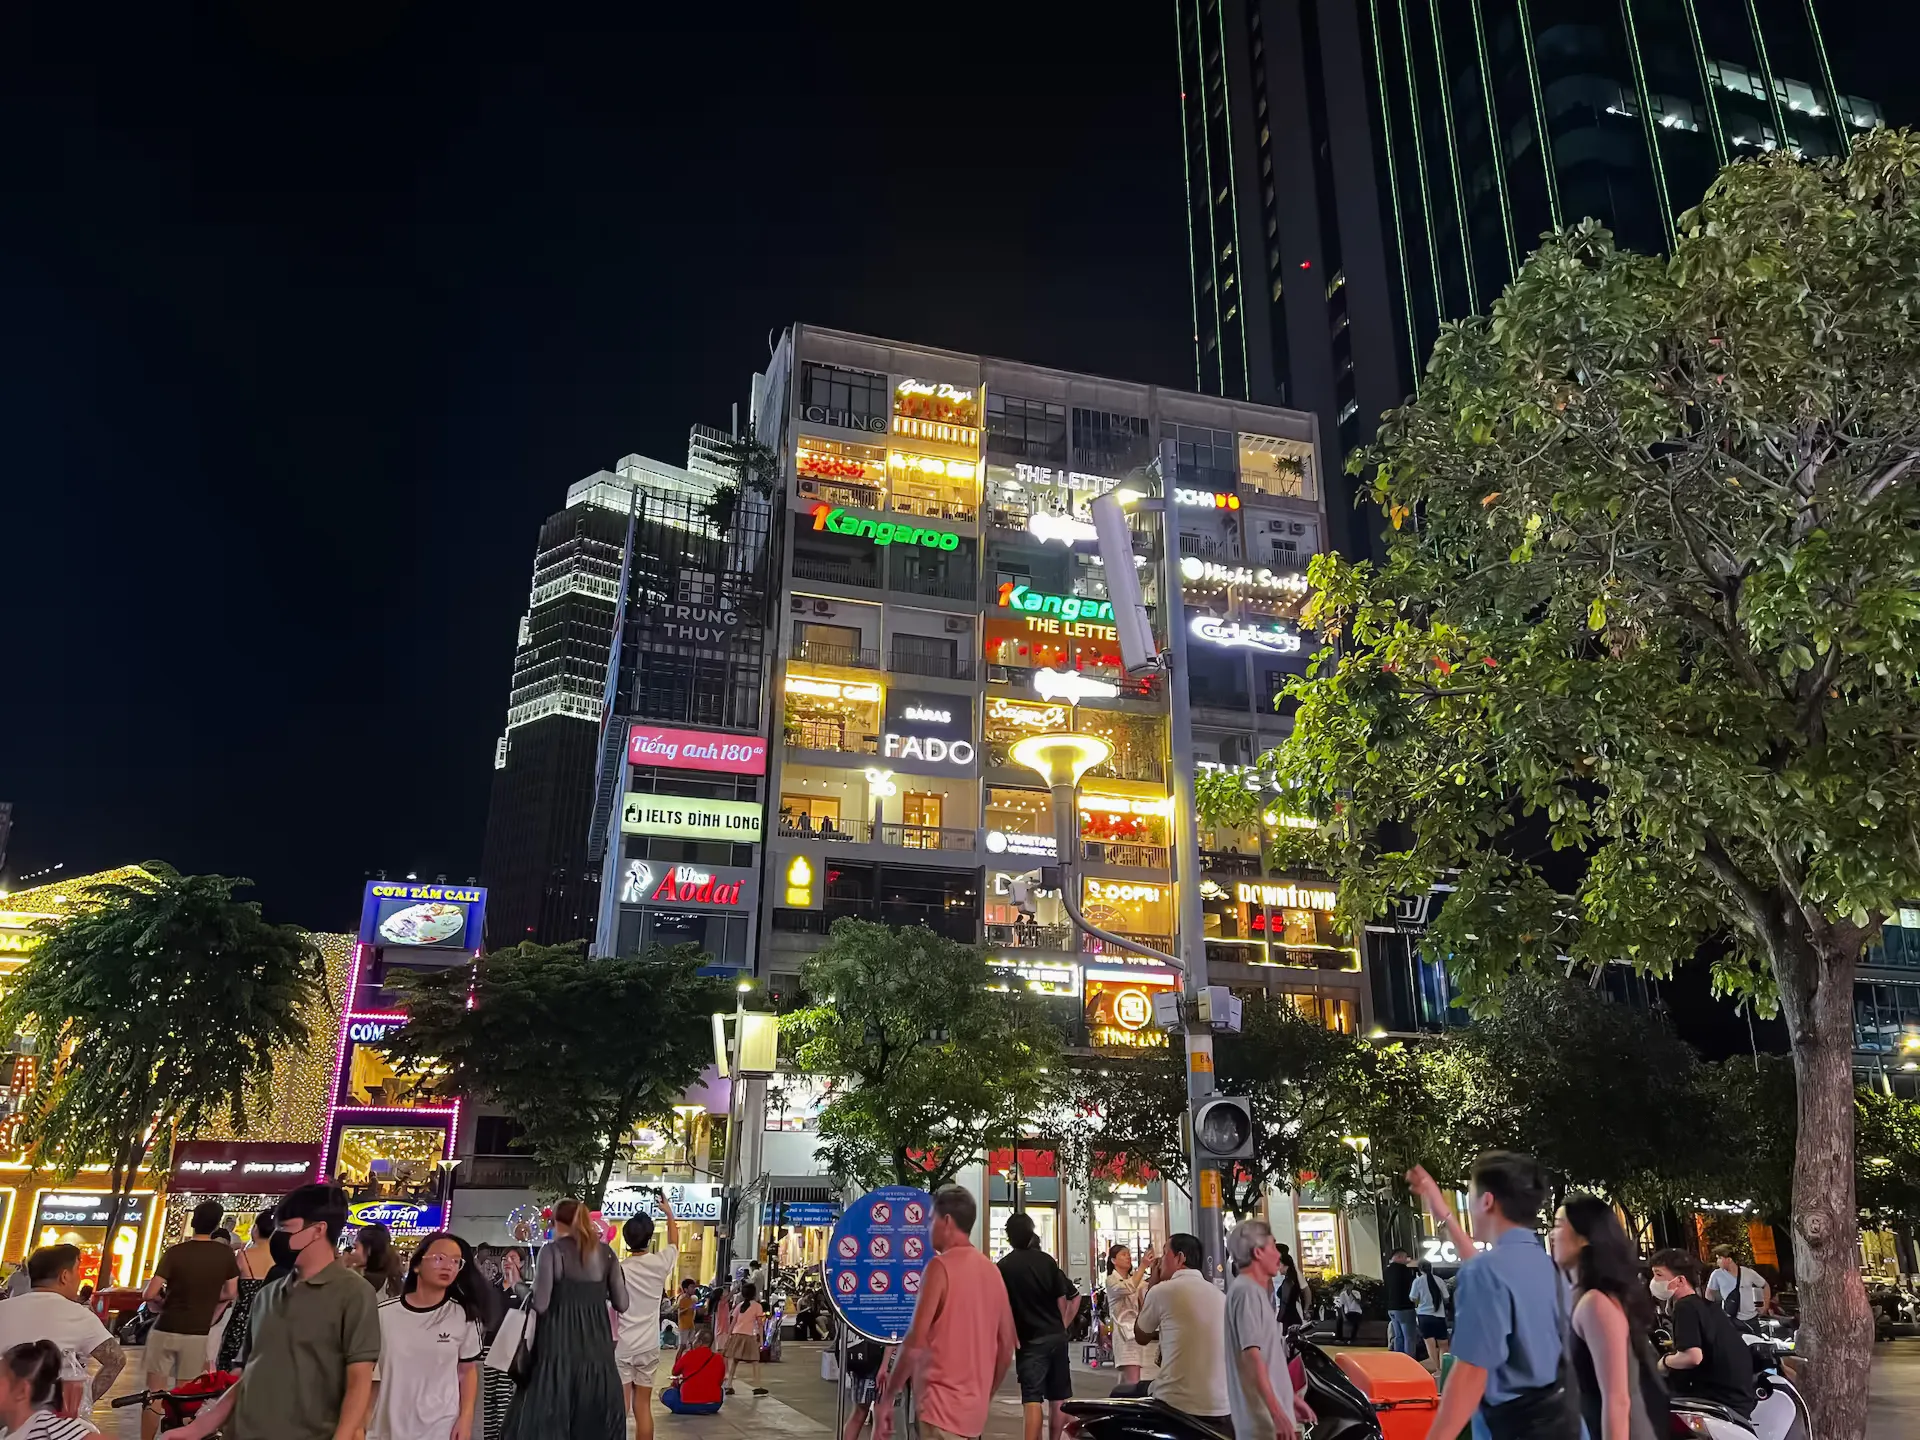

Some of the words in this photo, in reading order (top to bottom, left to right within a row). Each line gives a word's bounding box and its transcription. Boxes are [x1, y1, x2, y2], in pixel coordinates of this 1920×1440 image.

[1016, 463, 1052, 486] THE
[661, 603, 738, 625] TRUNG
[663, 623, 725, 643] THUY
[1025, 616, 1060, 634] THE
[1065, 622, 1120, 641] LETTE
[1192, 616, 1301, 652] Carlsberg
[632, 735, 678, 760] Tiếng
[682, 743, 718, 760] anh
[720, 744, 752, 762] 180
[885, 733, 975, 765] FADO
[646, 809, 682, 825] IELTS
[726, 815, 760, 831] LONG
[372, 886, 408, 898] CƠM
[410, 885, 442, 899] TẤM
[444, 890, 480, 902] CALI
[606, 1201, 645, 1213] XING
[675, 1202, 716, 1214] TANG
[391, 1220, 416, 1228] CALI
